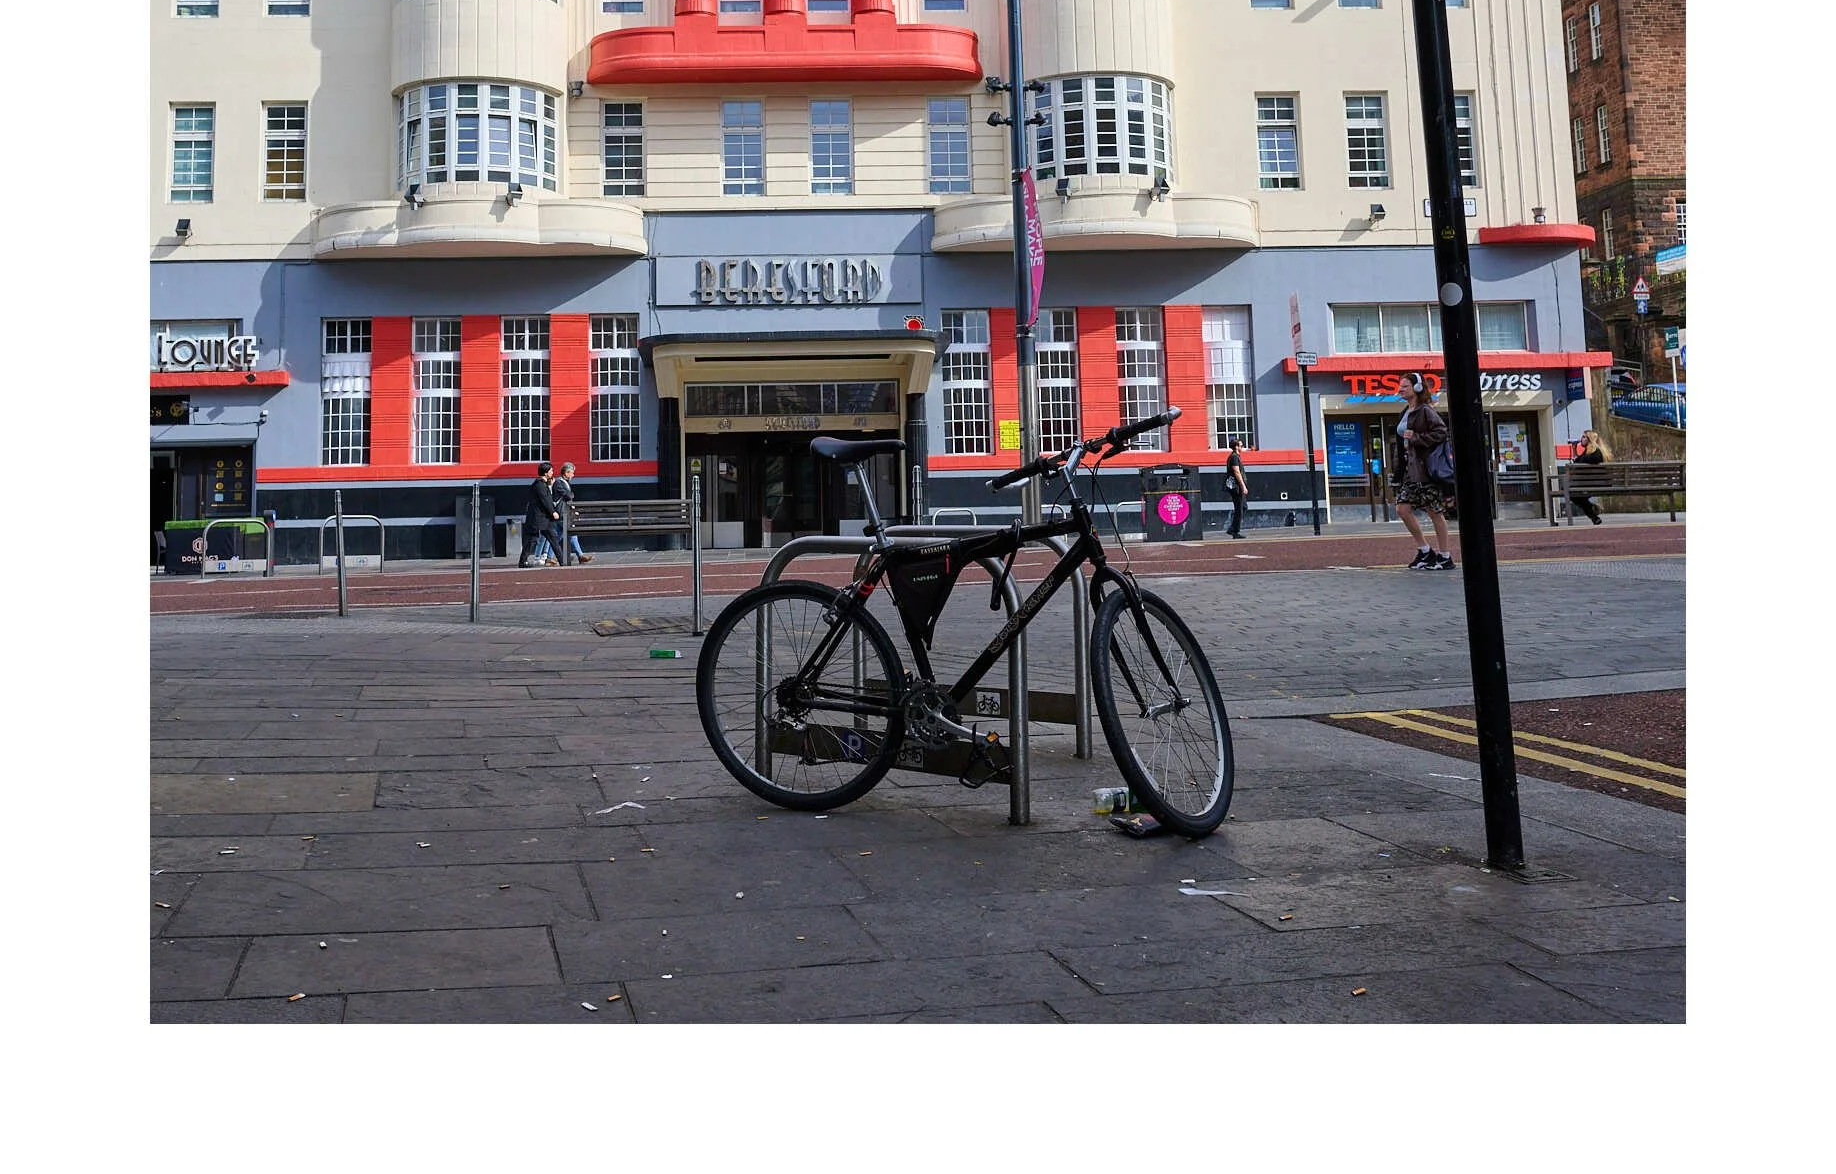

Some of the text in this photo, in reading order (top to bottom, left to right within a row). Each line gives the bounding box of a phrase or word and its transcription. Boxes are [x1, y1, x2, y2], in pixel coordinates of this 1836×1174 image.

[696, 258, 882, 303] BERESFORD
[156, 332, 259, 367] LOUNGE
[1343, 372, 1542, 395] TESO press
